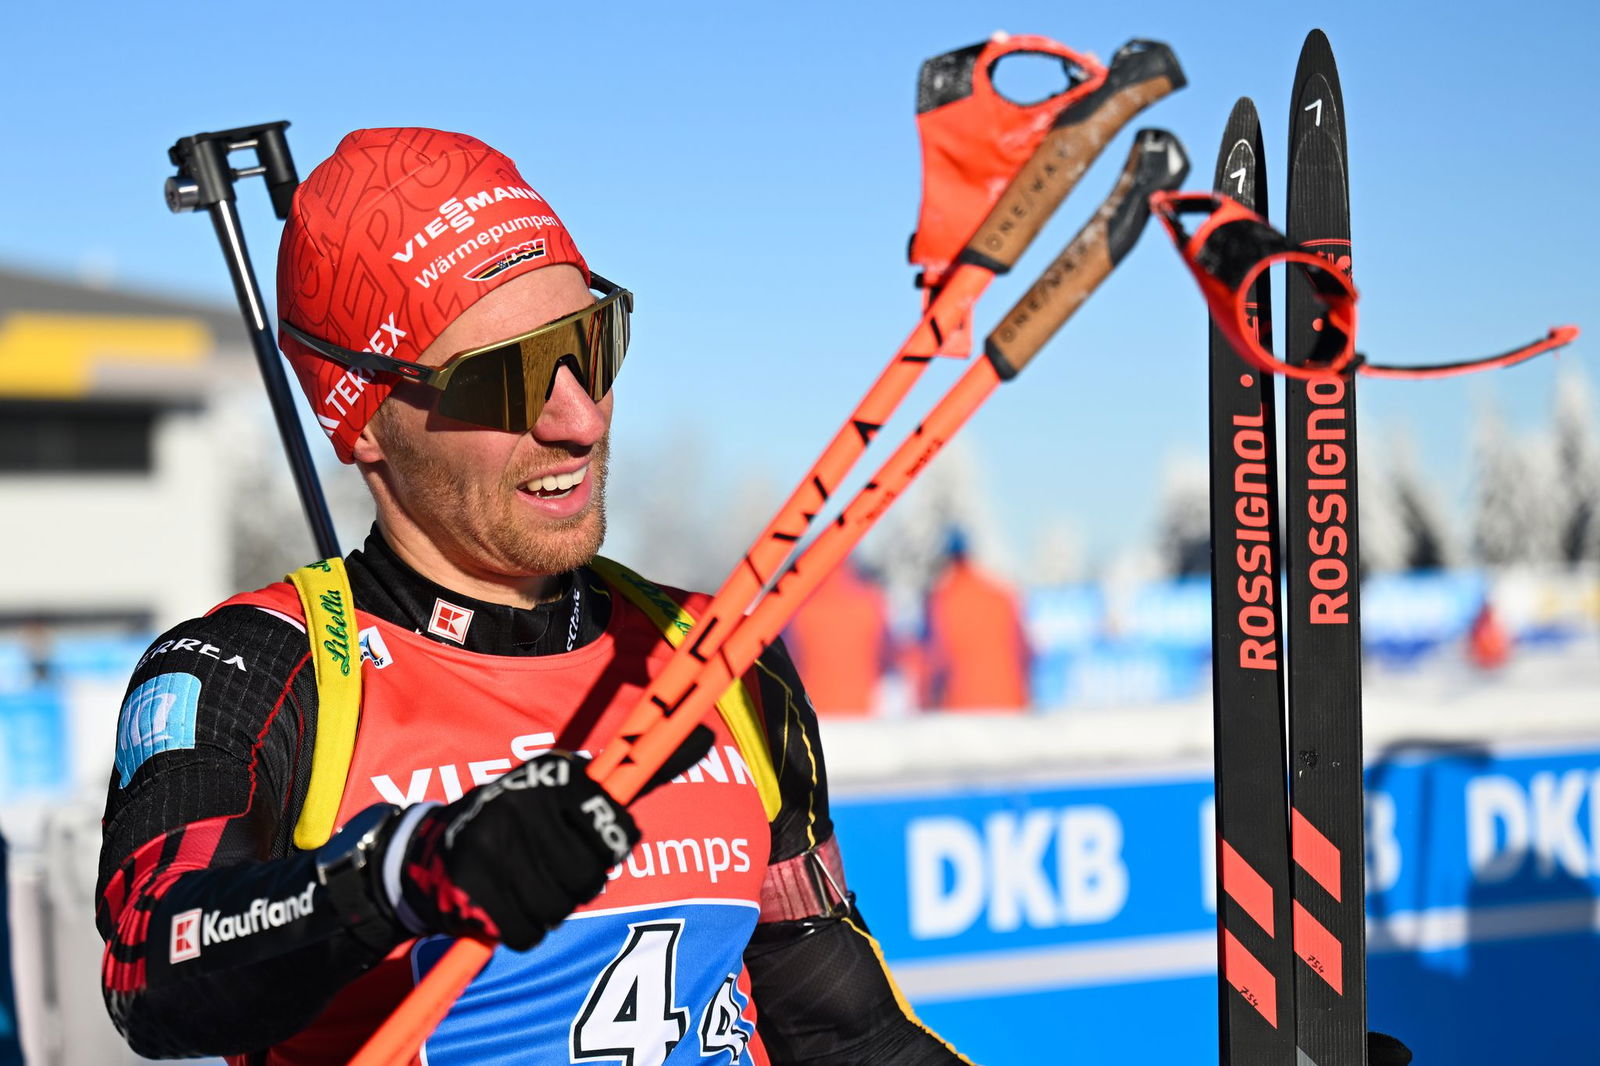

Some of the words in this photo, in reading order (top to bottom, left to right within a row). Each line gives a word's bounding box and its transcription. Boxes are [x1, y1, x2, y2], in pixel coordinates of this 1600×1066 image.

[414, 215, 559, 289] Wärmepumpen
[325, 312, 407, 416] TEREX
[1233, 402, 1277, 670] ROSSIGNOL
[1306, 376, 1349, 624] ROSSIGNO
[320, 589, 351, 677] Libella
[907, 805, 1130, 940] DKB
[1465, 768, 1600, 884] DK
[202, 882, 317, 946] Kaufland
[570, 919, 690, 1066] 4
[1240, 985, 1259, 1007] 754
[1306, 954, 1325, 974] 754
[700, 974, 749, 1066] 4
